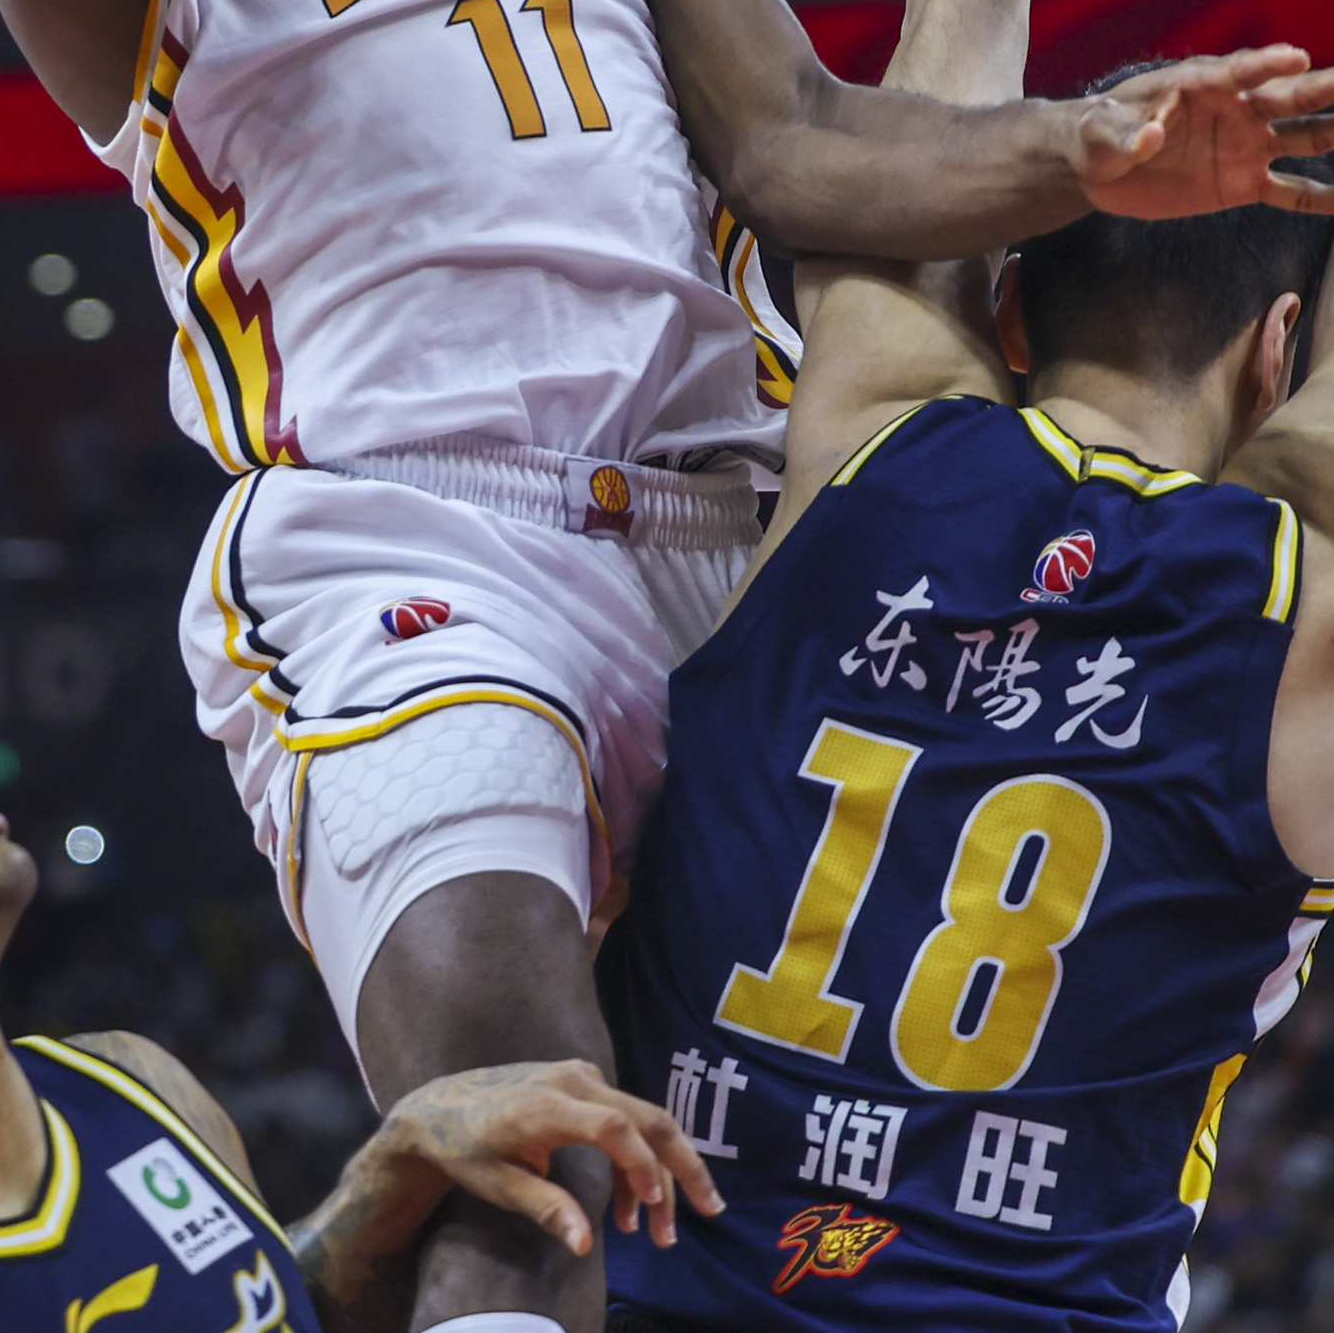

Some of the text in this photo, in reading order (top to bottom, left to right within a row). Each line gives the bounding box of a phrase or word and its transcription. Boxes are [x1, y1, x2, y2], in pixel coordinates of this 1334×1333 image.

[713, 717, 1113, 1092] 18
[667, 1047, 1067, 1231] 杜润旺
